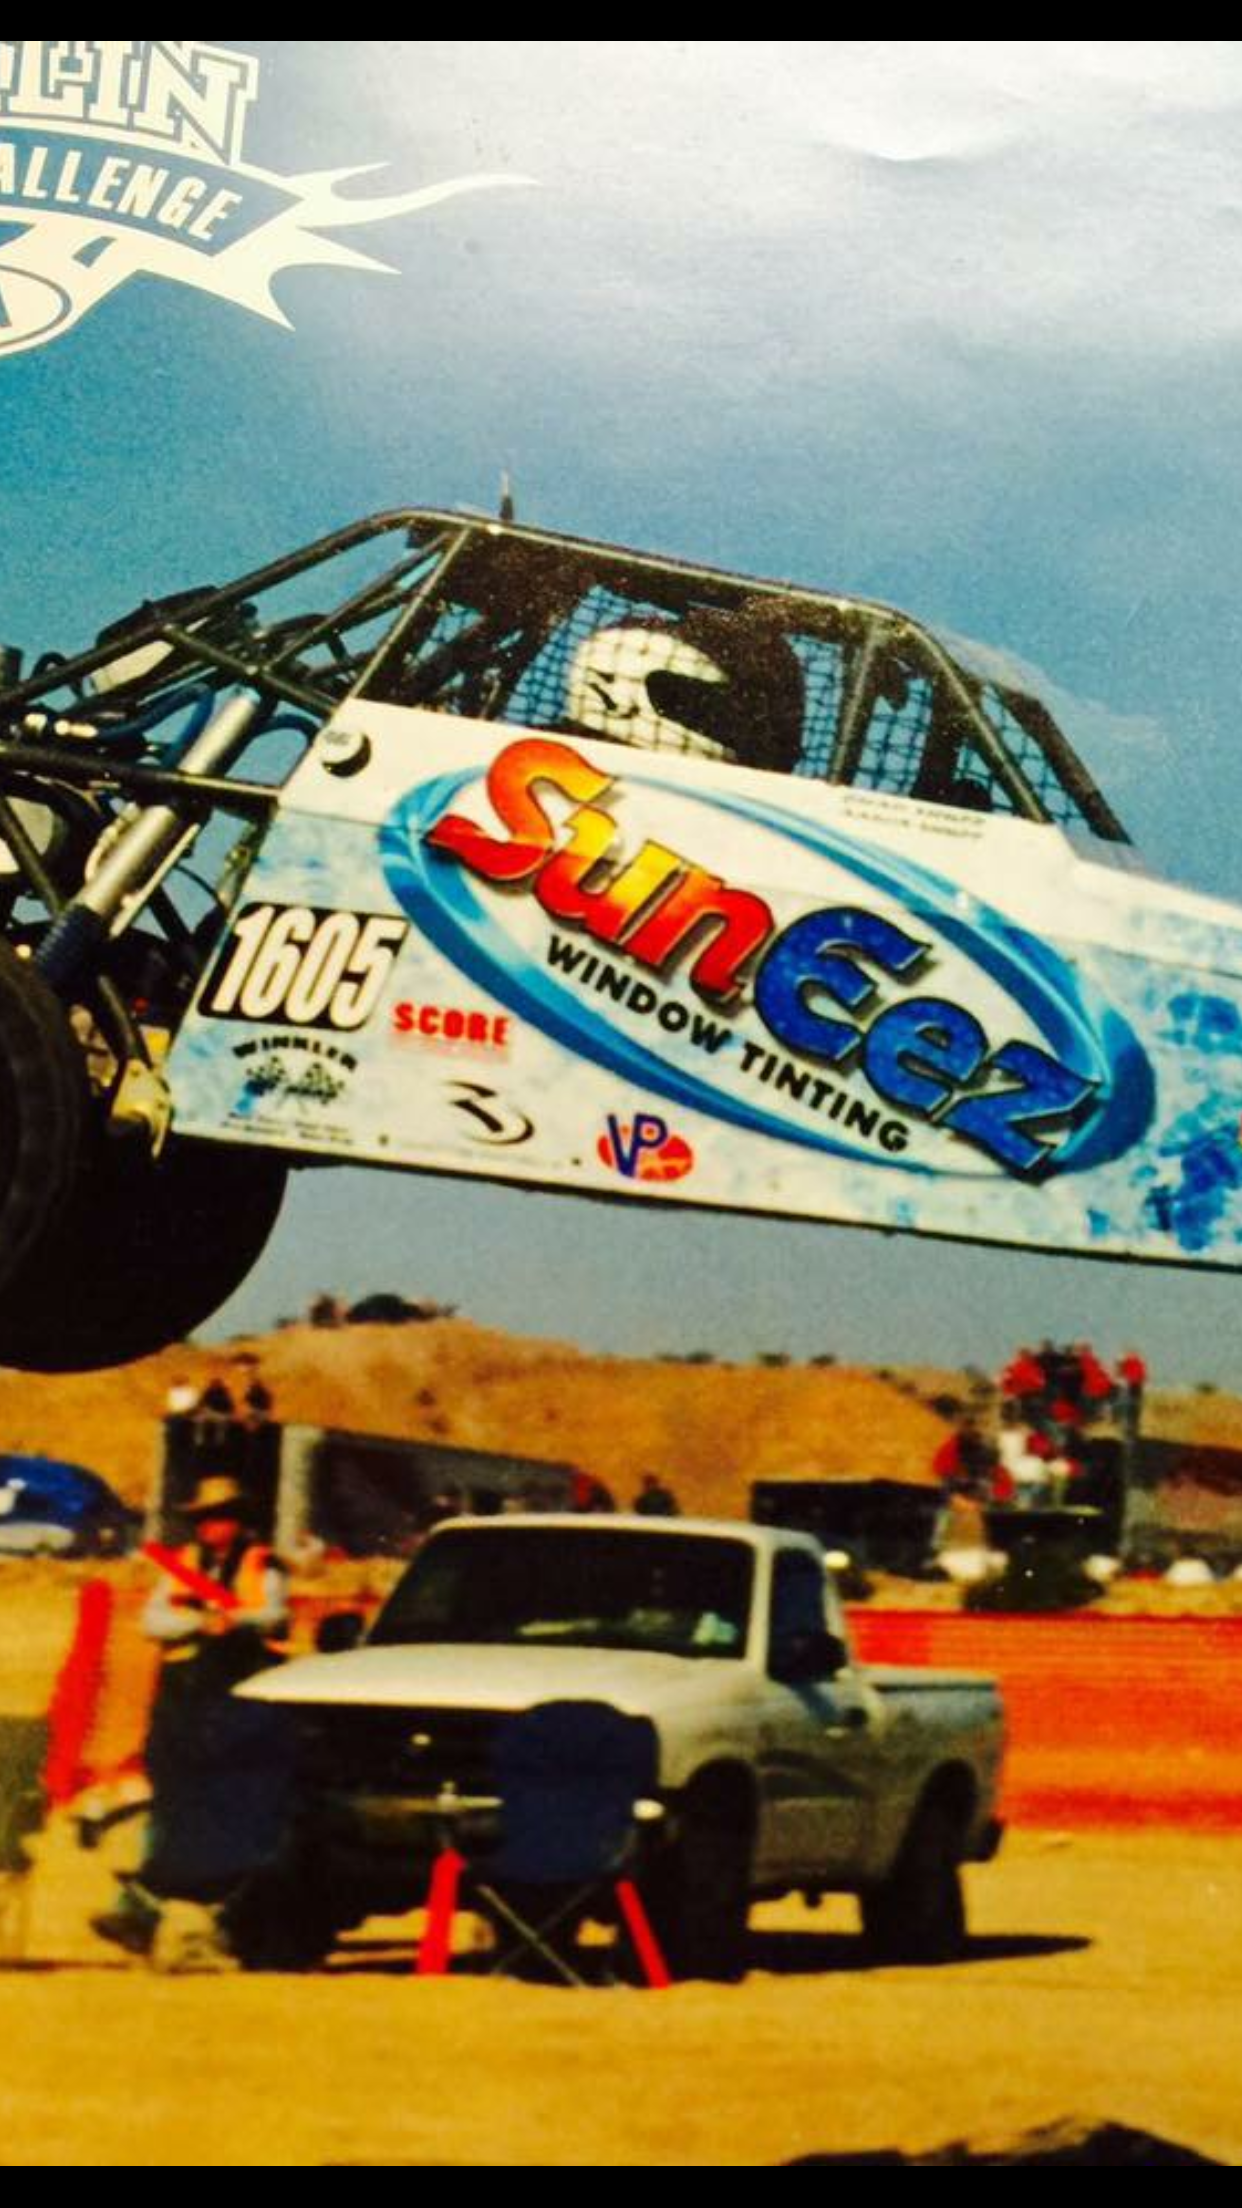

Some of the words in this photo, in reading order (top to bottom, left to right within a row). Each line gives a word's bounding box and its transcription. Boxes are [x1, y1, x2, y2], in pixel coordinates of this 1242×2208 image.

[212, 904, 406, 1030] 1605
[394, 1002, 511, 1048] SCORE
[548, 935, 732, 1054] WINDOW
[740, 1040, 910, 1152] TINTING
